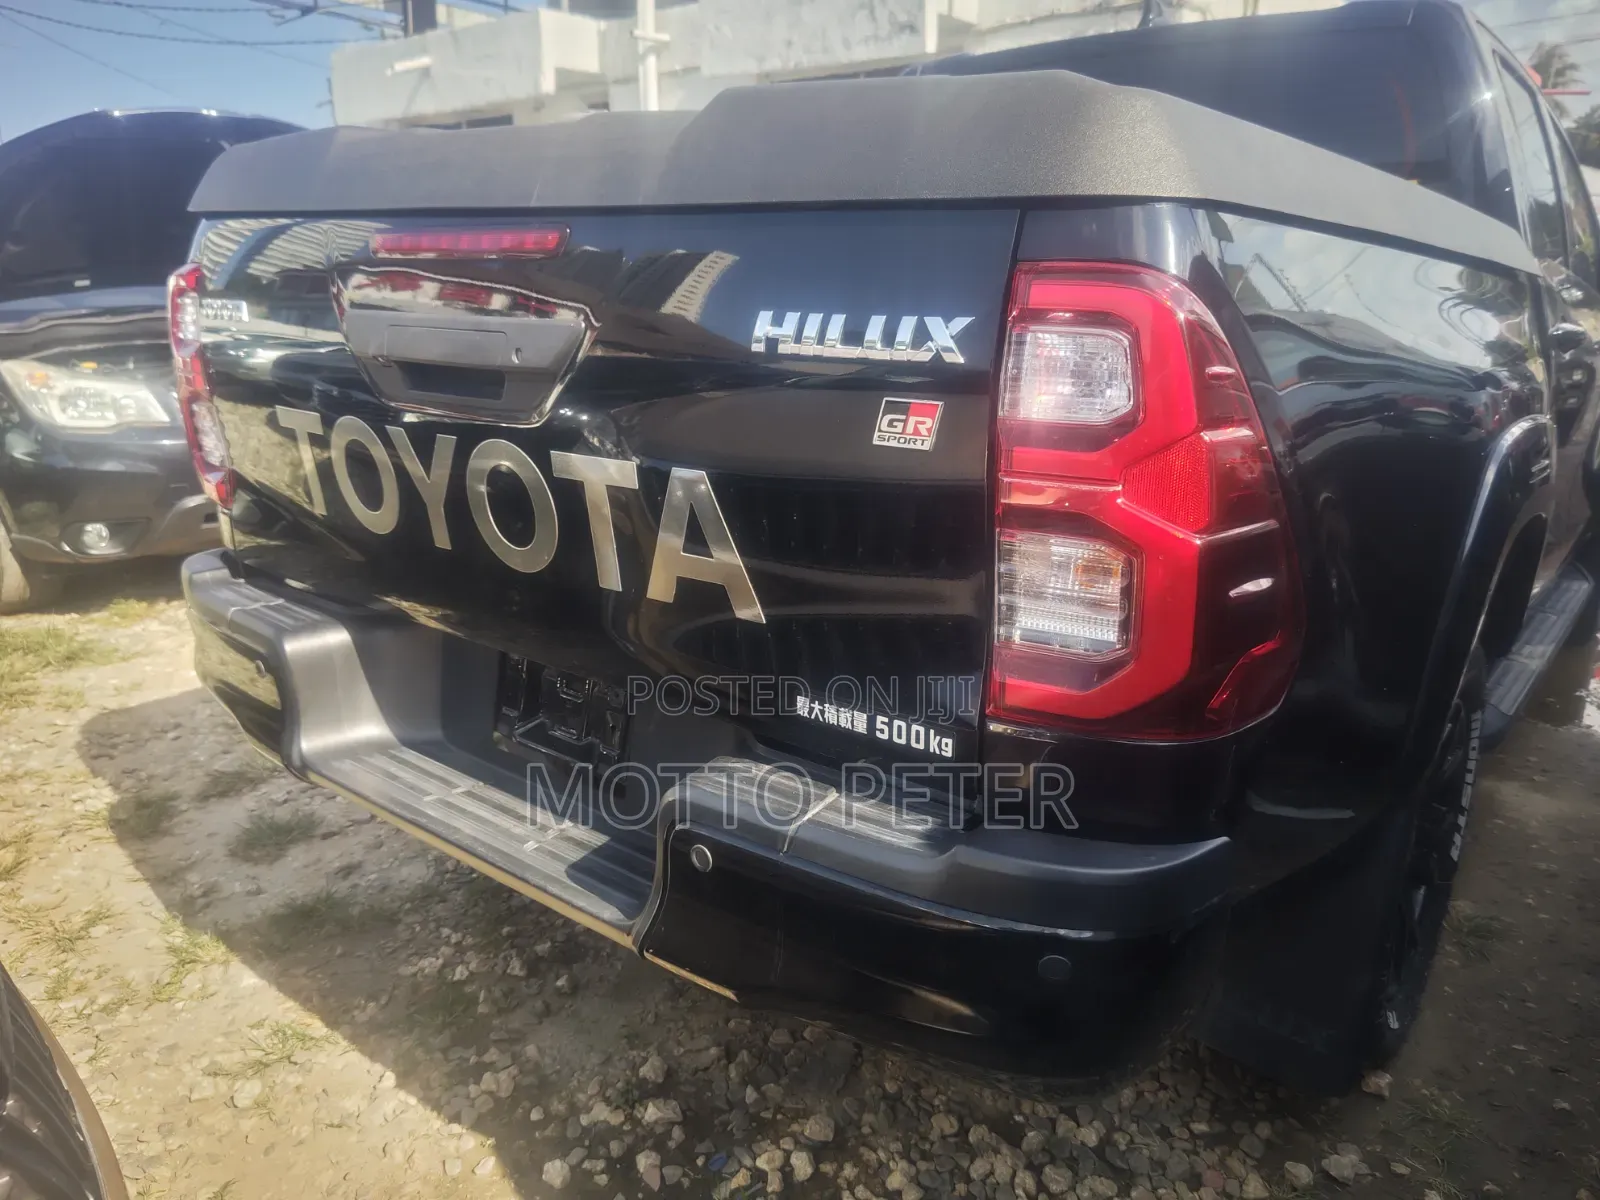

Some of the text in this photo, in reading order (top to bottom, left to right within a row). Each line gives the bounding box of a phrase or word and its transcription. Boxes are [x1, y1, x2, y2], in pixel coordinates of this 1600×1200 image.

[751, 310, 976, 364] HILUX
[876, 433, 929, 447] SPORT
[879, 414, 934, 437] GR
[275, 404, 767, 625] TOYOTA
[875, 714, 954, 759] 500kg
